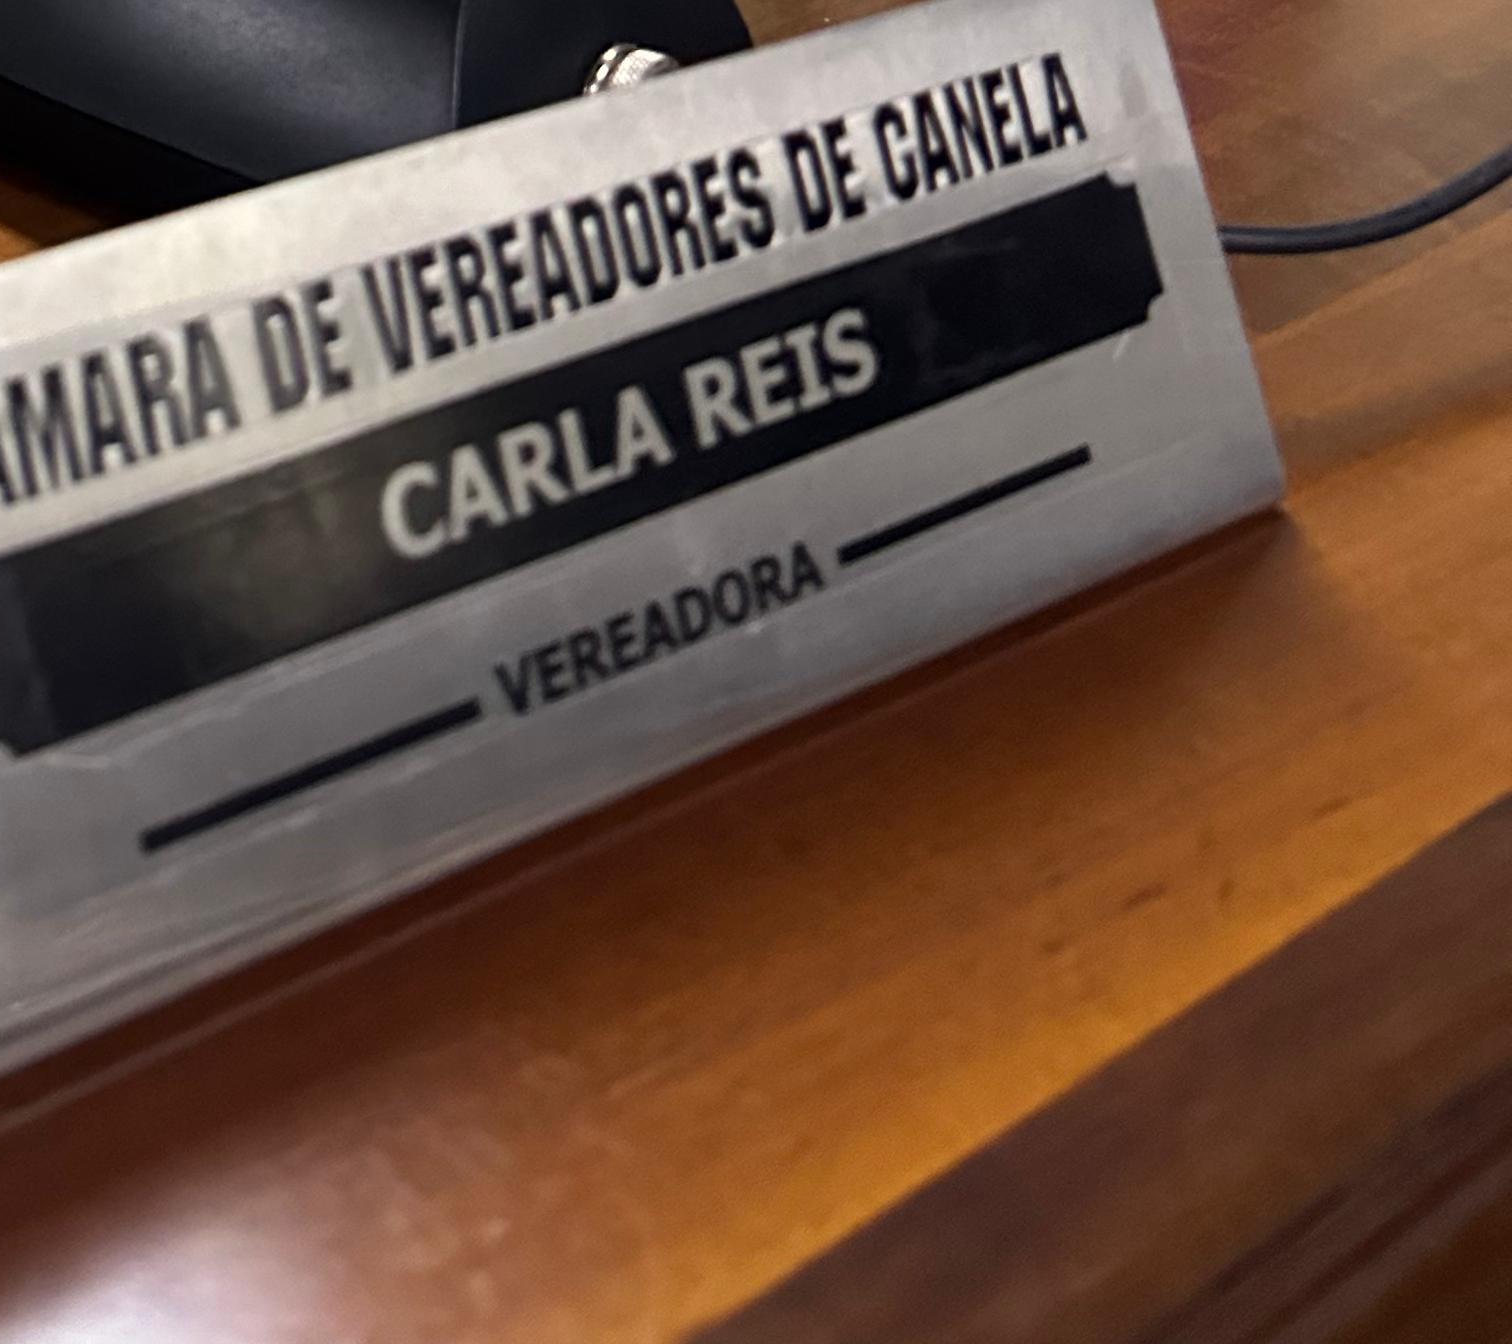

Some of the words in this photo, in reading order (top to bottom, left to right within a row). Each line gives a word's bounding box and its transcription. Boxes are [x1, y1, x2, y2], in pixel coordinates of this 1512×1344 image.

[251, 277, 354, 413] DE
[359, 146, 779, 375] VEREADORES
[783, 118, 868, 234] DE
[872, 52, 1088, 201] CANELA
[379, 384, 677, 560] CARLA
[681, 307, 882, 451] REIS
[492, 539, 828, 716] VEREADORA
